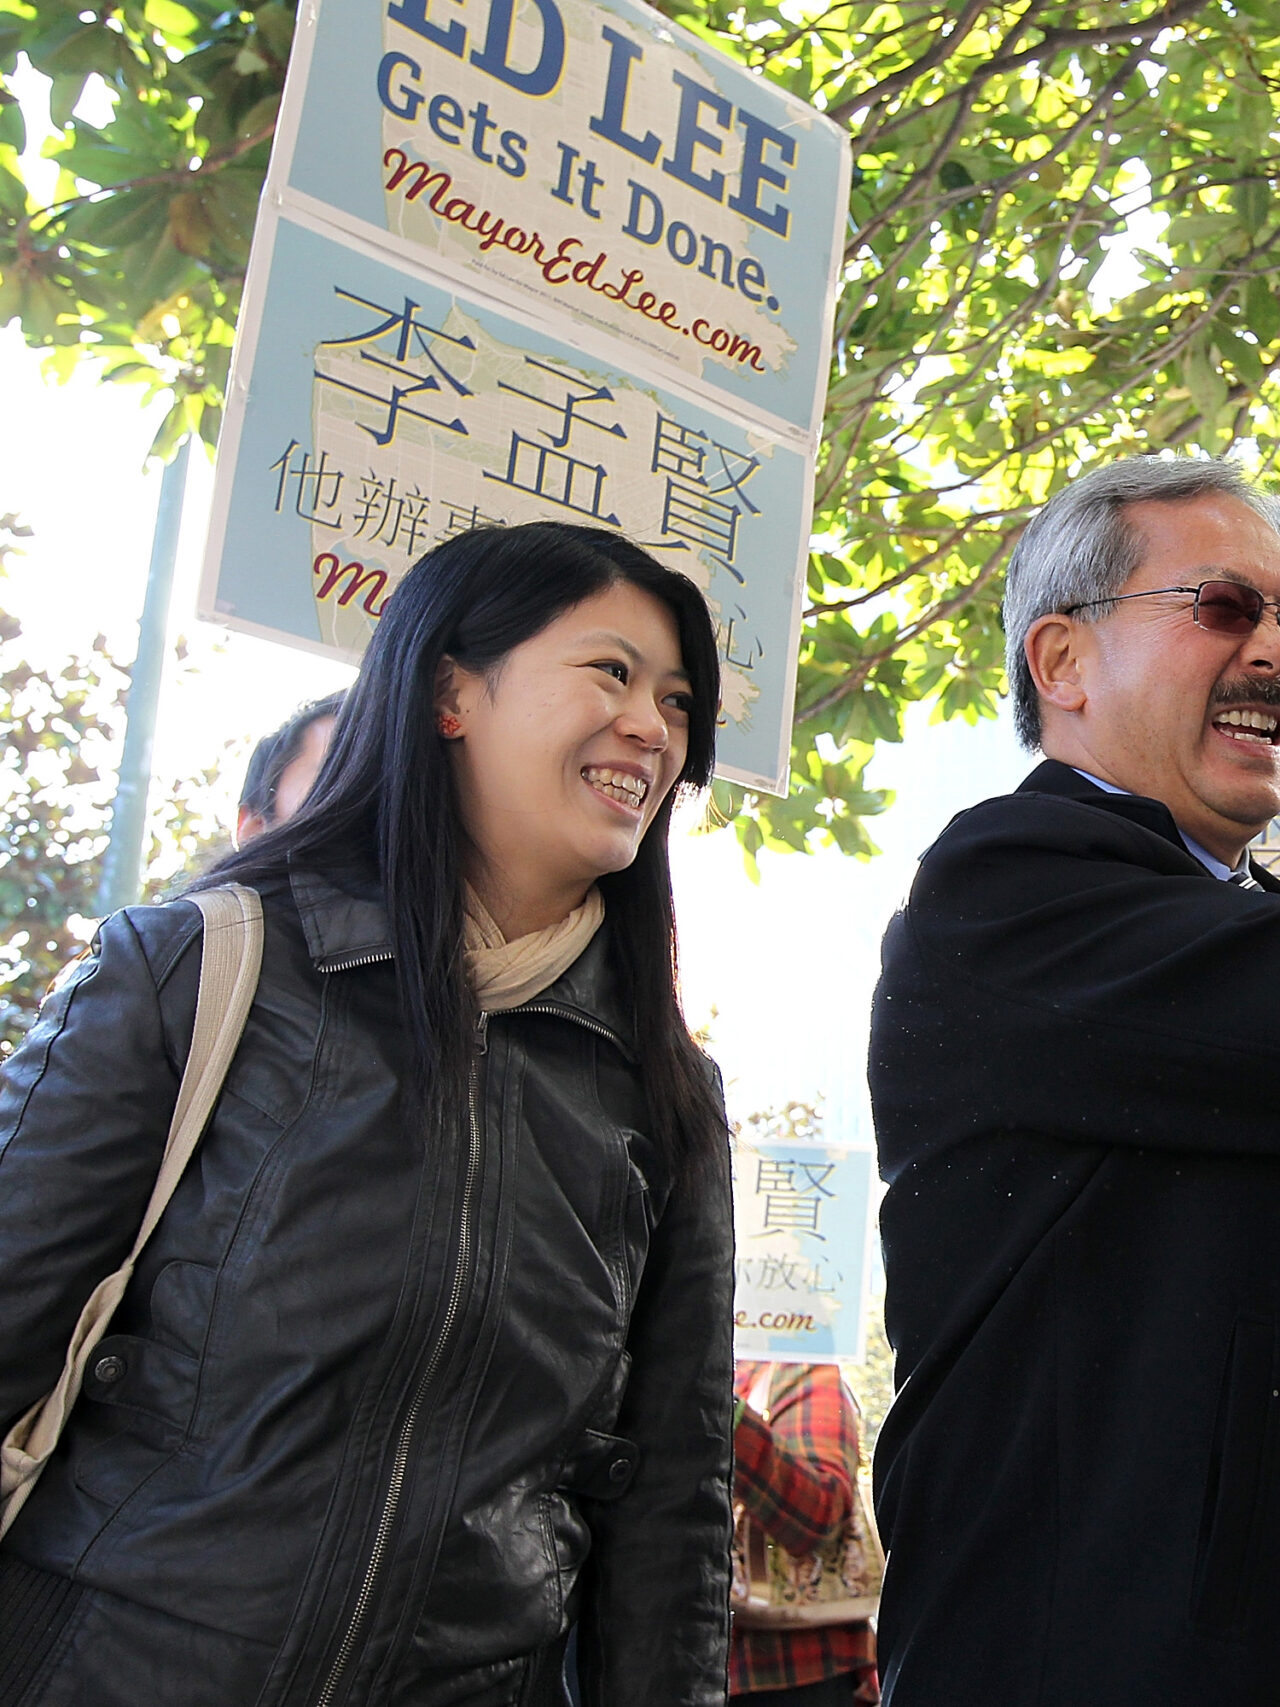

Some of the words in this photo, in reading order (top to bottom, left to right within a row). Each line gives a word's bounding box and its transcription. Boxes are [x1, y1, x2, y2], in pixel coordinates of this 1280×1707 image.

[377, 51, 528, 178] Gets
[551, 141, 604, 218] It
[623, 179, 779, 311] Done.
[589, 26, 796, 235] LEE
[384, 148, 764, 372] MayorEdLee.com
[314, 285, 762, 582] 李孟賢
[748, 1158, 837, 1242] 賢
